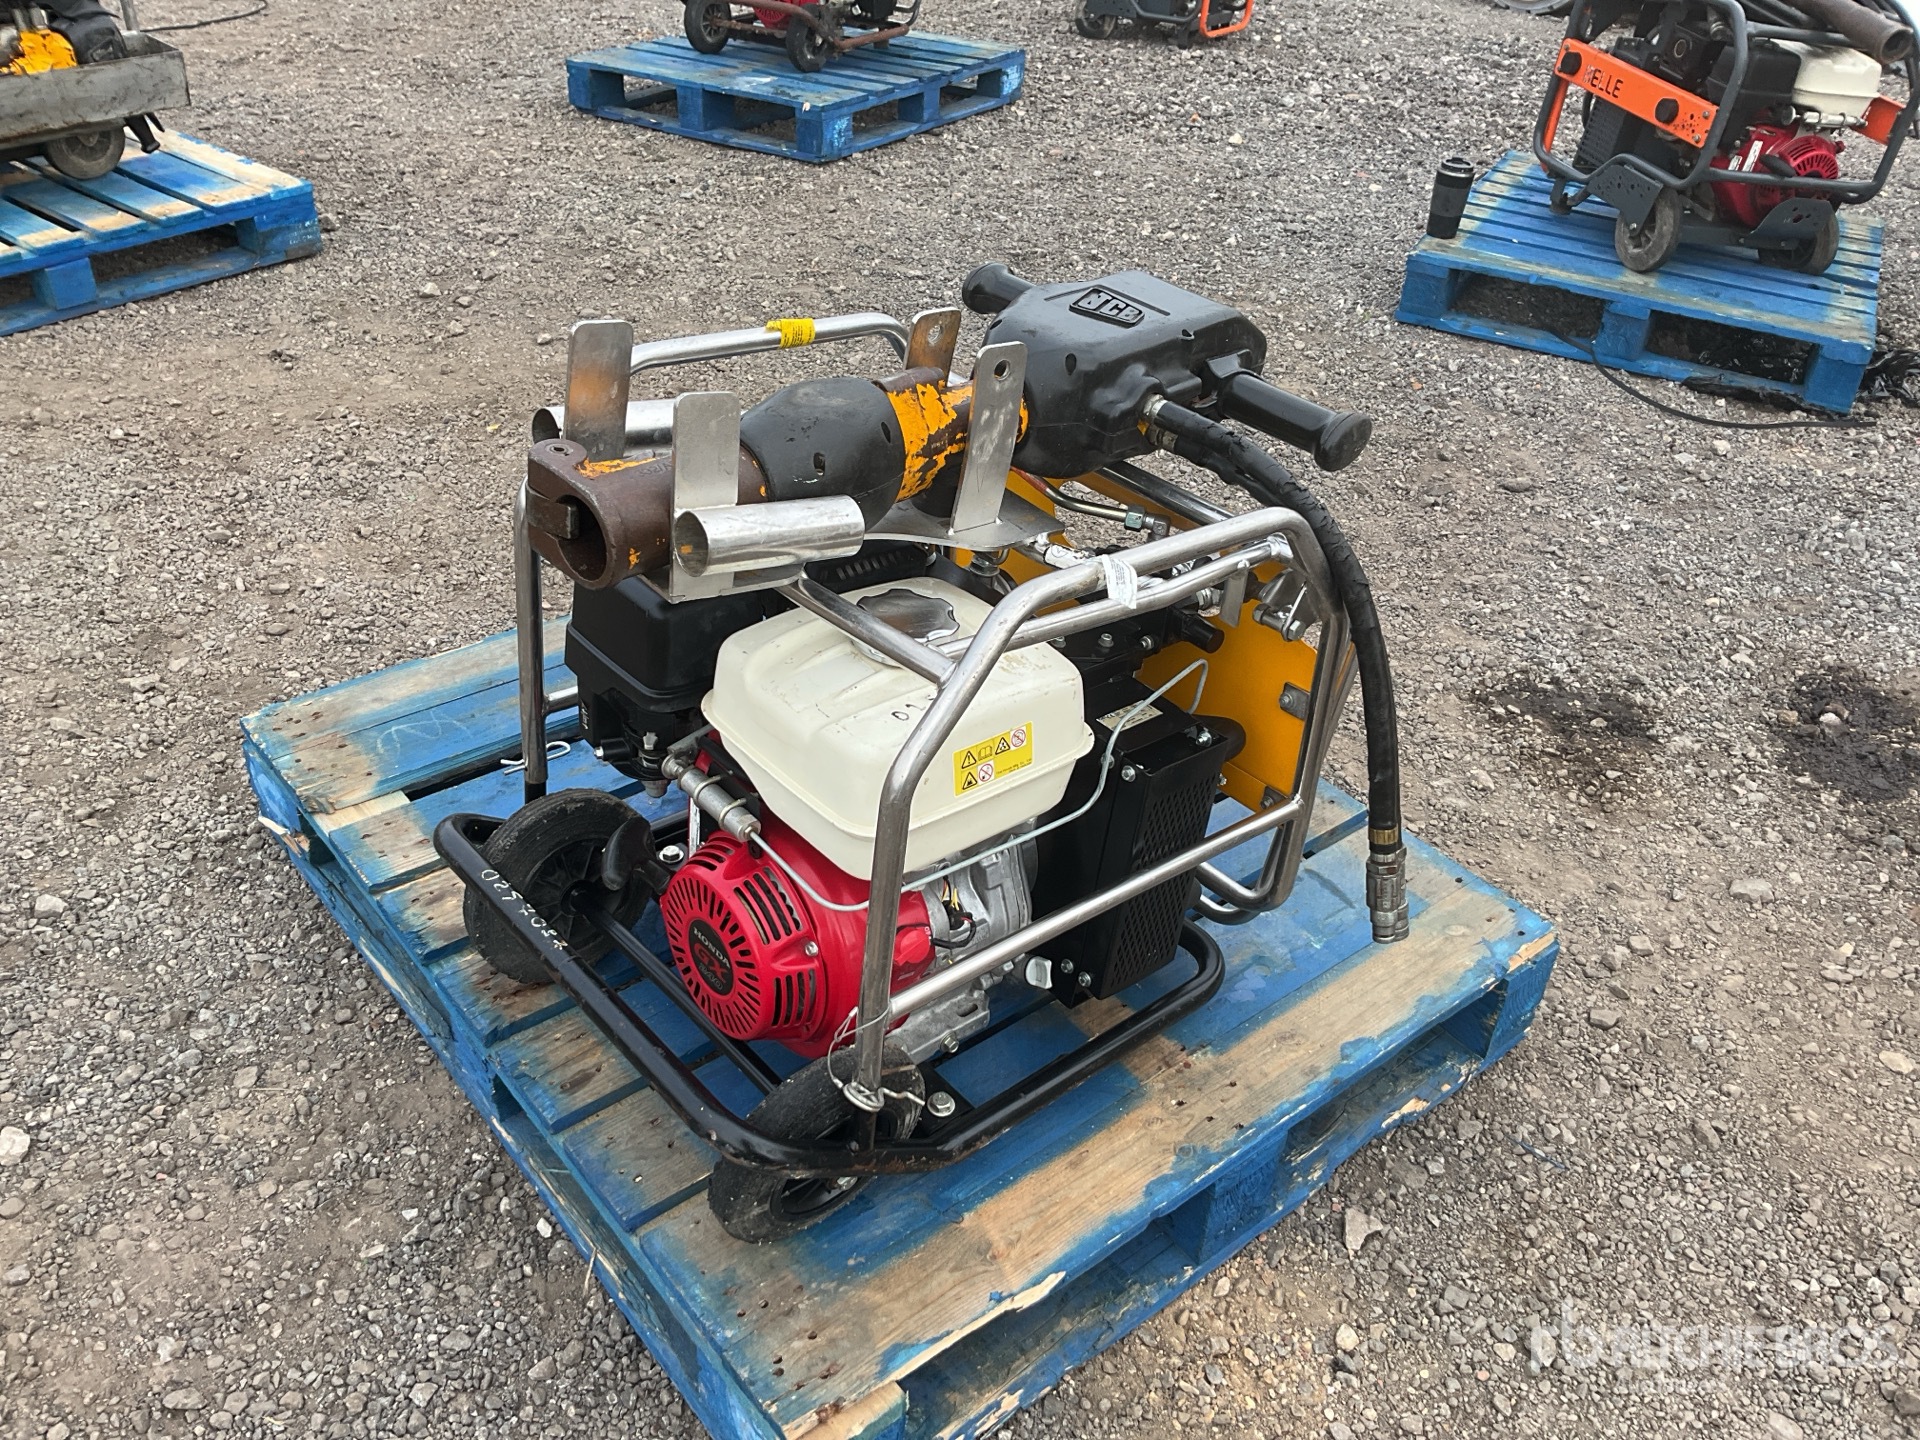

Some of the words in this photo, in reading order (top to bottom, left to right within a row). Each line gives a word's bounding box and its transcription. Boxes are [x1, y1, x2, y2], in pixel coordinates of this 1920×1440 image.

[1076, 291, 1142, 322] JCB
[693, 926, 731, 969] HONDA
[694, 943, 728, 984] GX
